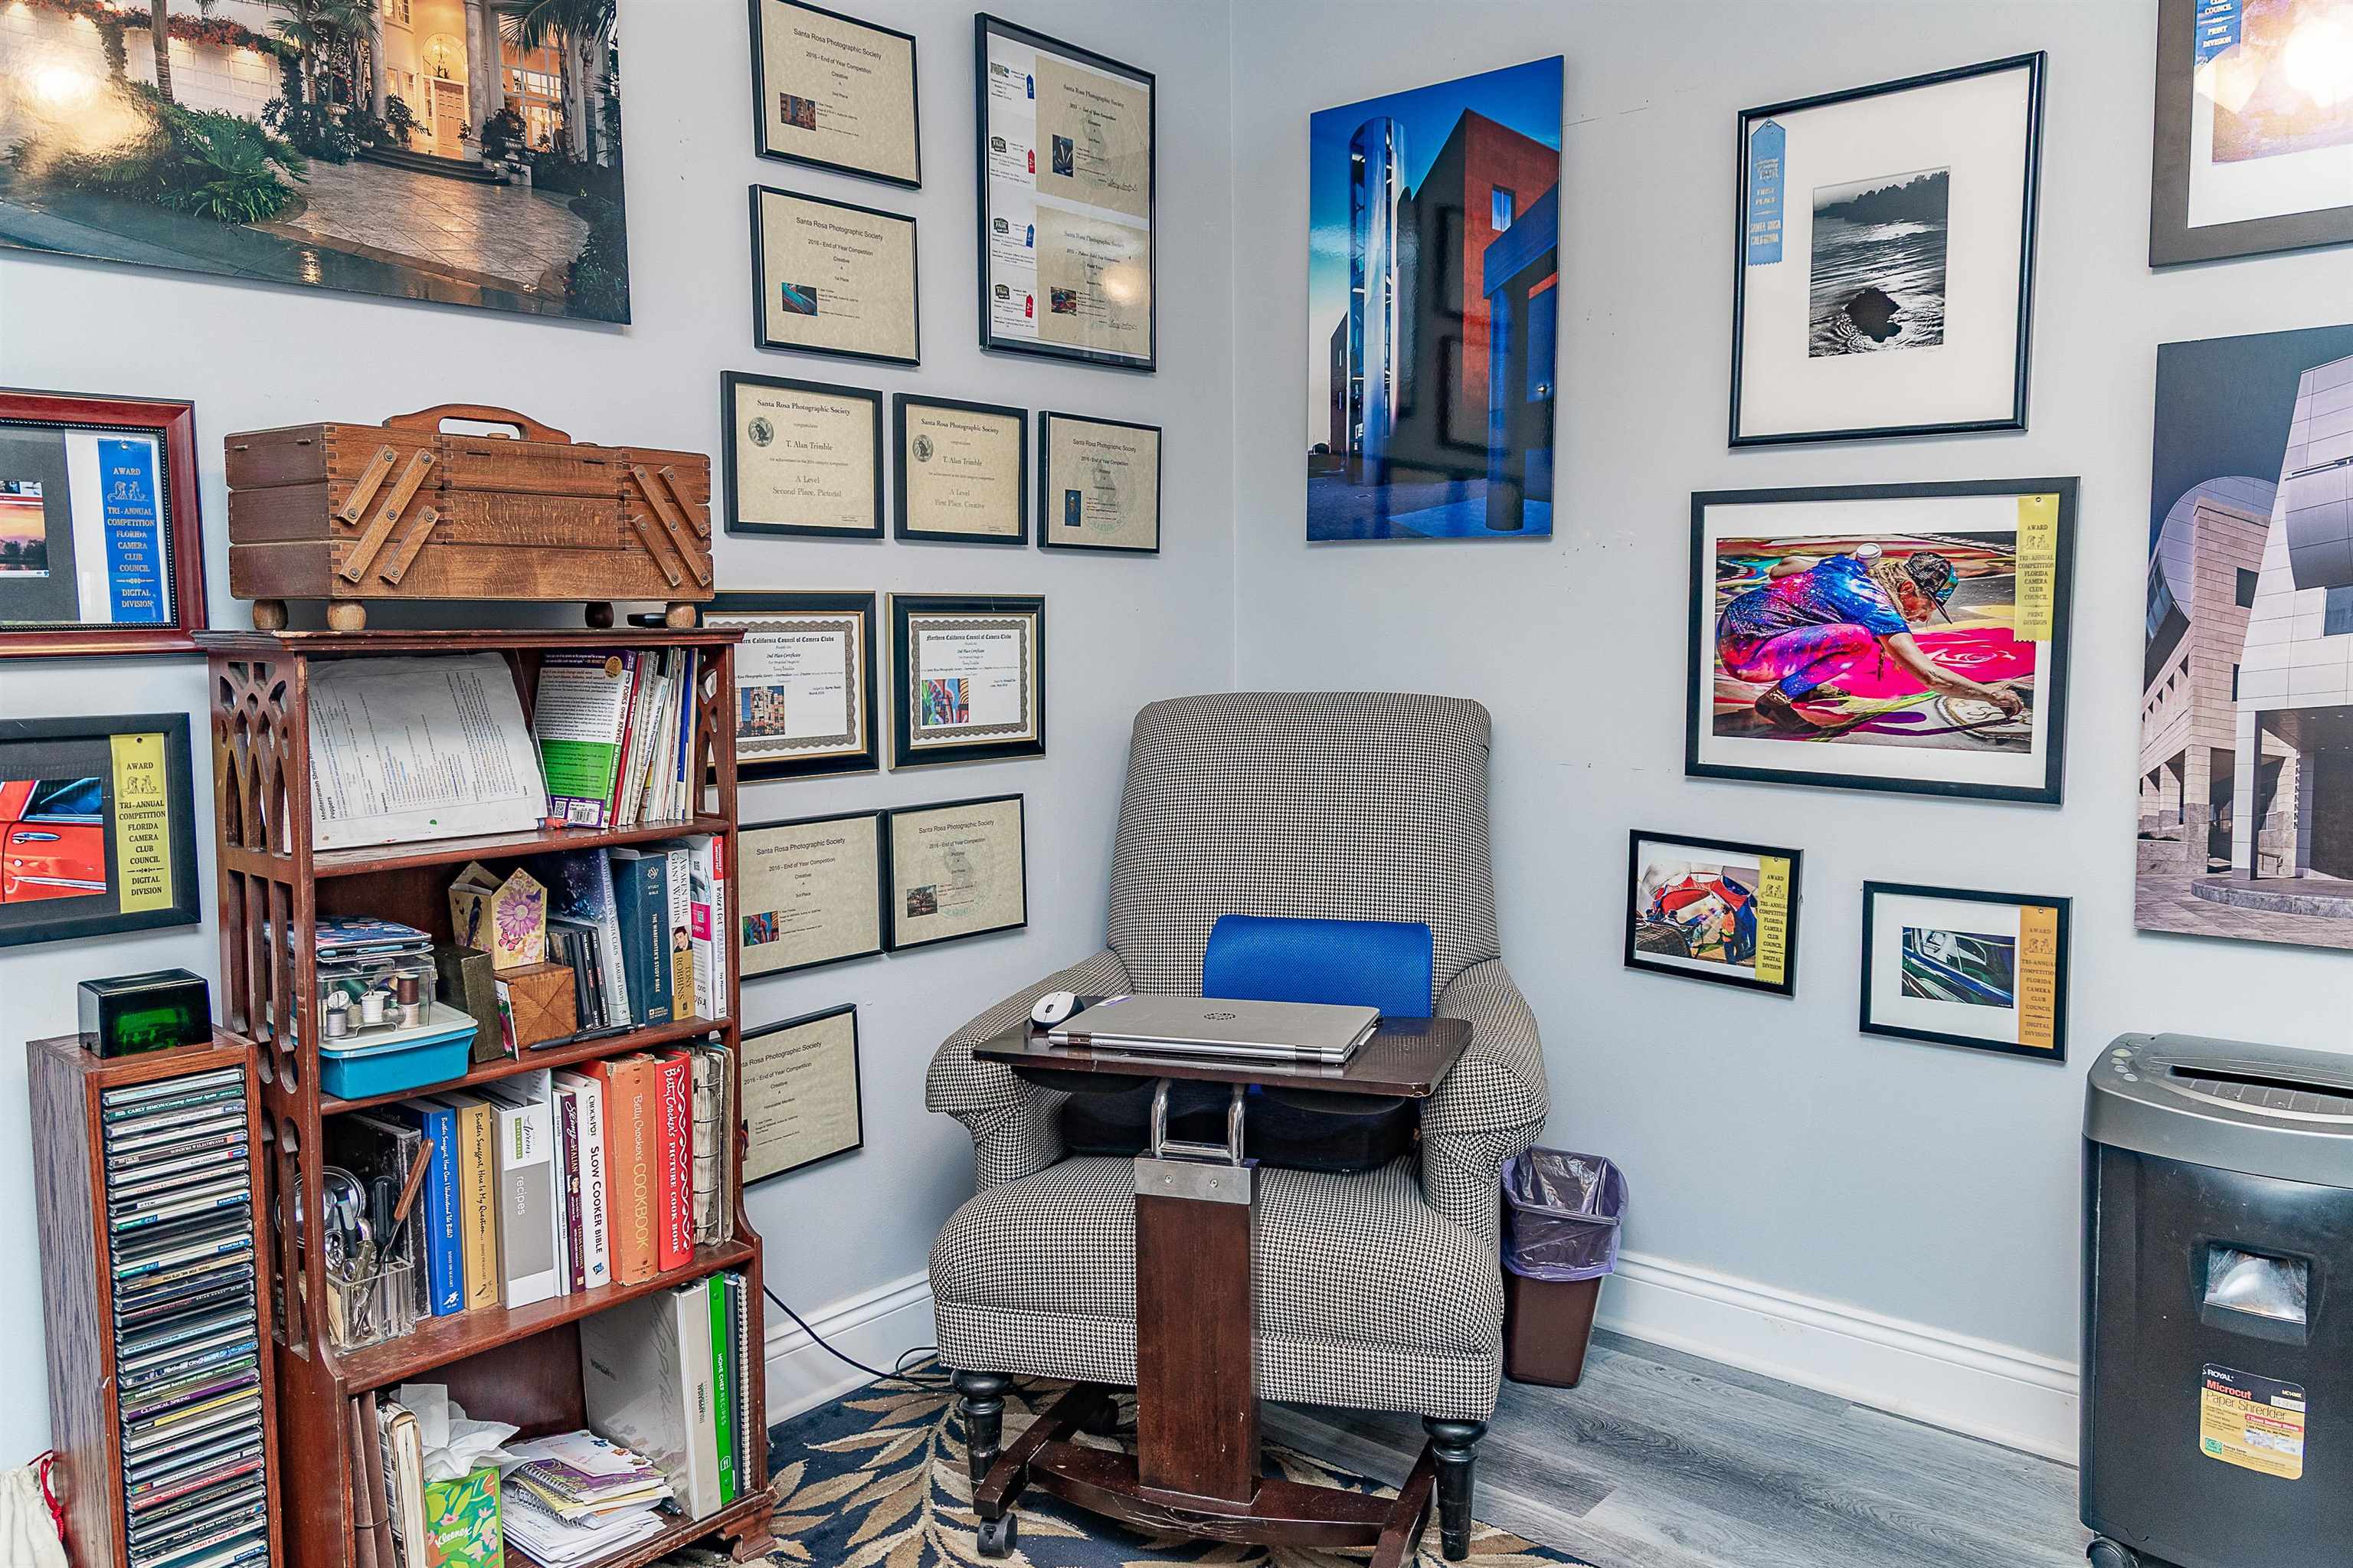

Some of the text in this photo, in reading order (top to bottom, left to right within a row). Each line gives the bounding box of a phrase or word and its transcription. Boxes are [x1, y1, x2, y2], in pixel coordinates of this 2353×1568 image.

[794, 28, 882, 61] Santa Rosa Photographic Society
[796, 217, 883, 242] Santa Rosa Photographic Society
[758, 399, 774, 408] Santa
[792, 403, 830, 414] Photographic
[830, 407, 851, 417] Society
[950, 421, 981, 432] Photographic
[982, 425, 999, 435] Society
[794, 440, 808, 450] Alan
[809, 442, 833, 451] Trimble
[949, 457, 961, 465] Alan
[963, 458, 983, 466] Trimble
[817, 489, 842, 497] Pictorial
[117, 542, 148, 550] CAMERA
[119, 564, 150, 572] COUNCIL
[621, 686, 630, 705] FORKS
[616, 720, 624, 743] KNIVES
[126, 762, 154, 771] AWARD
[315, 781, 326, 820] Mediterranean
[119, 810, 166, 820] COMPETITION
[128, 823, 159, 831] FLORIDA
[129, 834, 159, 843] CAMERA
[790, 840, 825, 851] Photographic
[826, 837, 846, 846] Society
[136, 845, 154, 853] CLUB
[129, 856, 160, 865] COUNCIL
[671, 852, 679, 886] GIANT
[810, 857, 836, 866] Competition
[132, 876, 161, 885] DIGITAL
[679, 857, 688, 895] AWAKEN
[131, 886, 162, 896] DIVISION
[676, 957, 685, 1000] ROBBINS
[749, 1056, 764, 1066] Rosa
[765, 1046, 801, 1062] Photographic
[802, 1042, 822, 1052] Society
[786, 1062, 813, 1073] Competition
[663, 1068, 677, 1097] Betty
[127, 1105, 146, 1115] CARLY
[185, 1095, 204, 1104] Around
[475, 1112, 484, 1138] Brother
[565, 1101, 578, 1139] Skinny
[666, 1097, 677, 1138] Crocker's
[197, 1138, 224, 1148] PAVAROTTI
[474, 1138, 485, 1168] Swaggart,
[590, 1146, 600, 1180] SLOW
[633, 1093, 650, 1250] Betty Crocker's COOKBOOK
[477, 1170, 486, 1184] Here
[477, 1192, 486, 1204] My
[516, 1176, 526, 1216] recipes
[591, 1181, 602, 1227] COOKER
[2207, 1369, 2233, 1382] ROYAL
[2207, 1379, 2253, 1399] Microcut
[140, 1396, 191, 1415] CLASSICAL SPRING
[2206, 1390, 2235, 1407] Paper
[2238, 1400, 2287, 1421] Shredder
[434, 1527, 473, 1548] Kleenex
